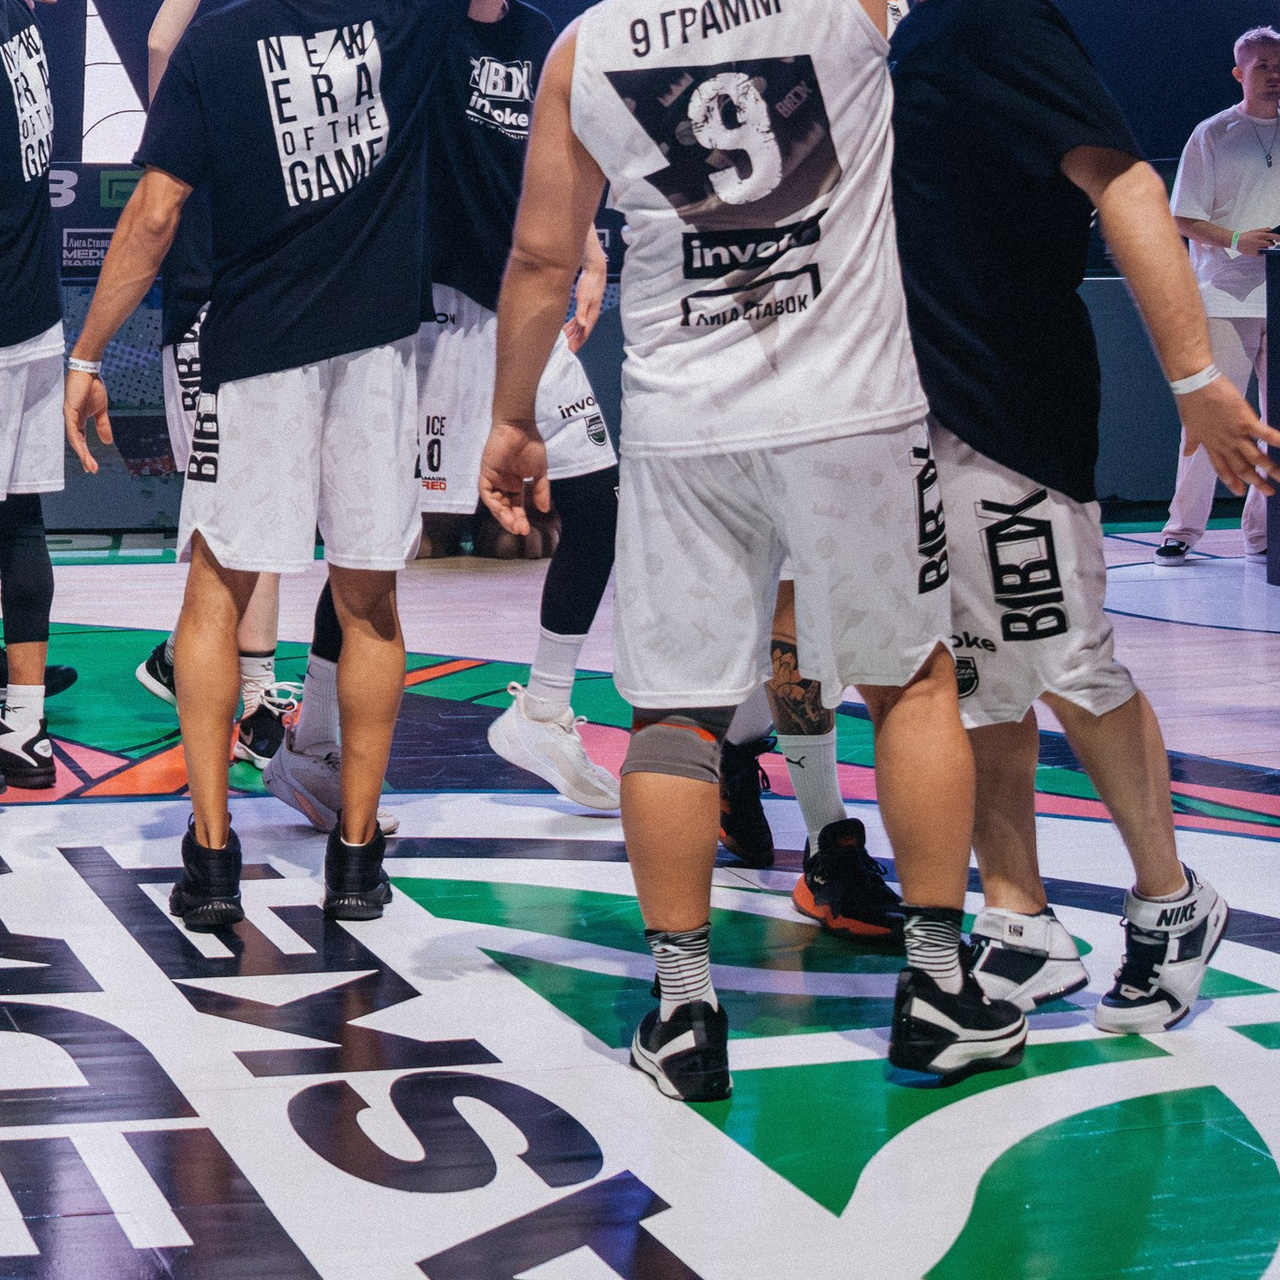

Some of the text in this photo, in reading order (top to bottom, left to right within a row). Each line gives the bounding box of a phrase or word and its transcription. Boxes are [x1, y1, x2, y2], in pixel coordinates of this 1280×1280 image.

[263, 23, 370, 73] NEW
[629, 18, 651, 58] 9
[271, 61, 375, 125] ERA
[328, 106, 382, 144] THE
[687, 72, 783, 206] 9
[288, 135, 384, 205] GAME
[1156, 900, 1198, 927] NIKE
